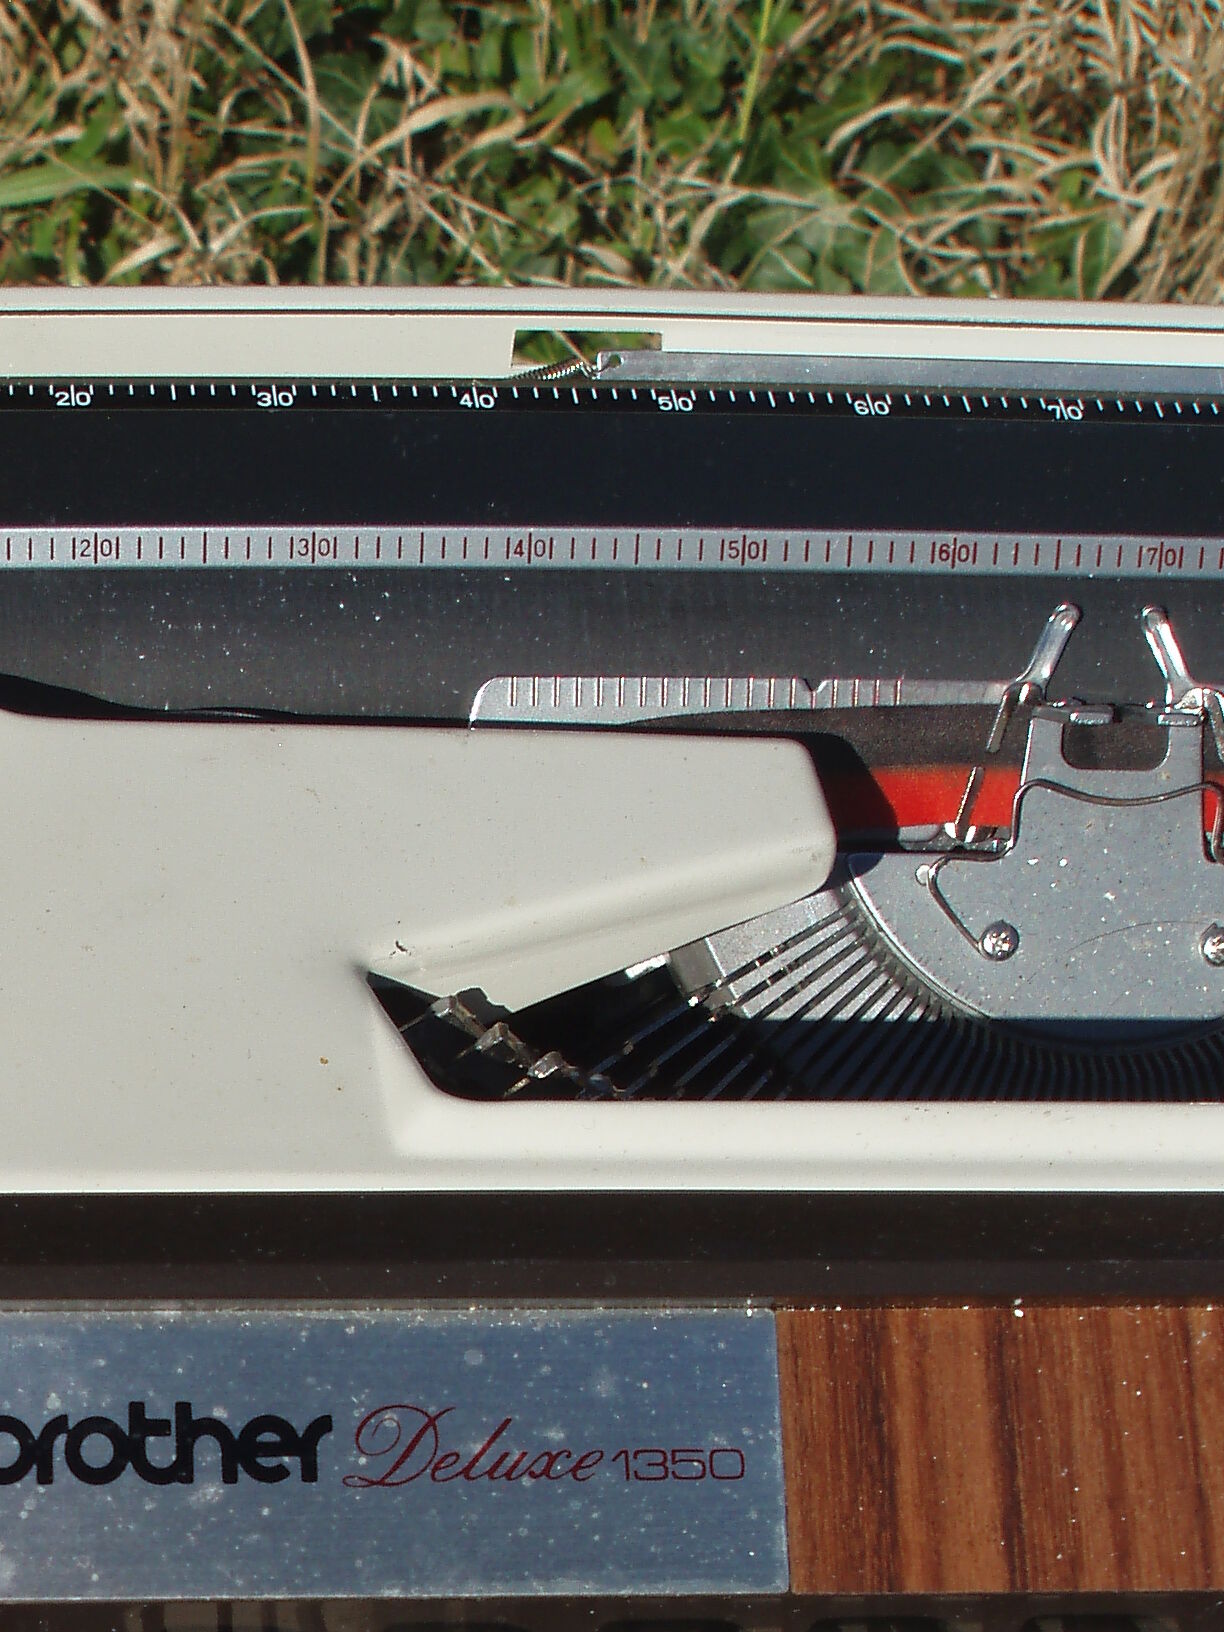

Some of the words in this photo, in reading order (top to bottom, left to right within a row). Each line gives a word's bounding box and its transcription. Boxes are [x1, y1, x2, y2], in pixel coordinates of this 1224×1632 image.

[55, 390, 91, 408] 20
[256, 390, 294, 408] 30
[459, 393, 495, 408] 40
[657, 393, 693, 412] 50
[853, 397, 889, 416] 60
[1047, 401, 1083, 421] 70
[79, 539, 113, 558] 20
[297, 539, 331, 558] 30
[513, 539, 547, 558] 40
[728, 539, 762, 560] 50
[937, 540, 971, 561] 60
[1145, 544, 1179, 565] 70
[343, 1404, 607, 1488] Deluxe
[609, 1448, 746, 1481] 1350
